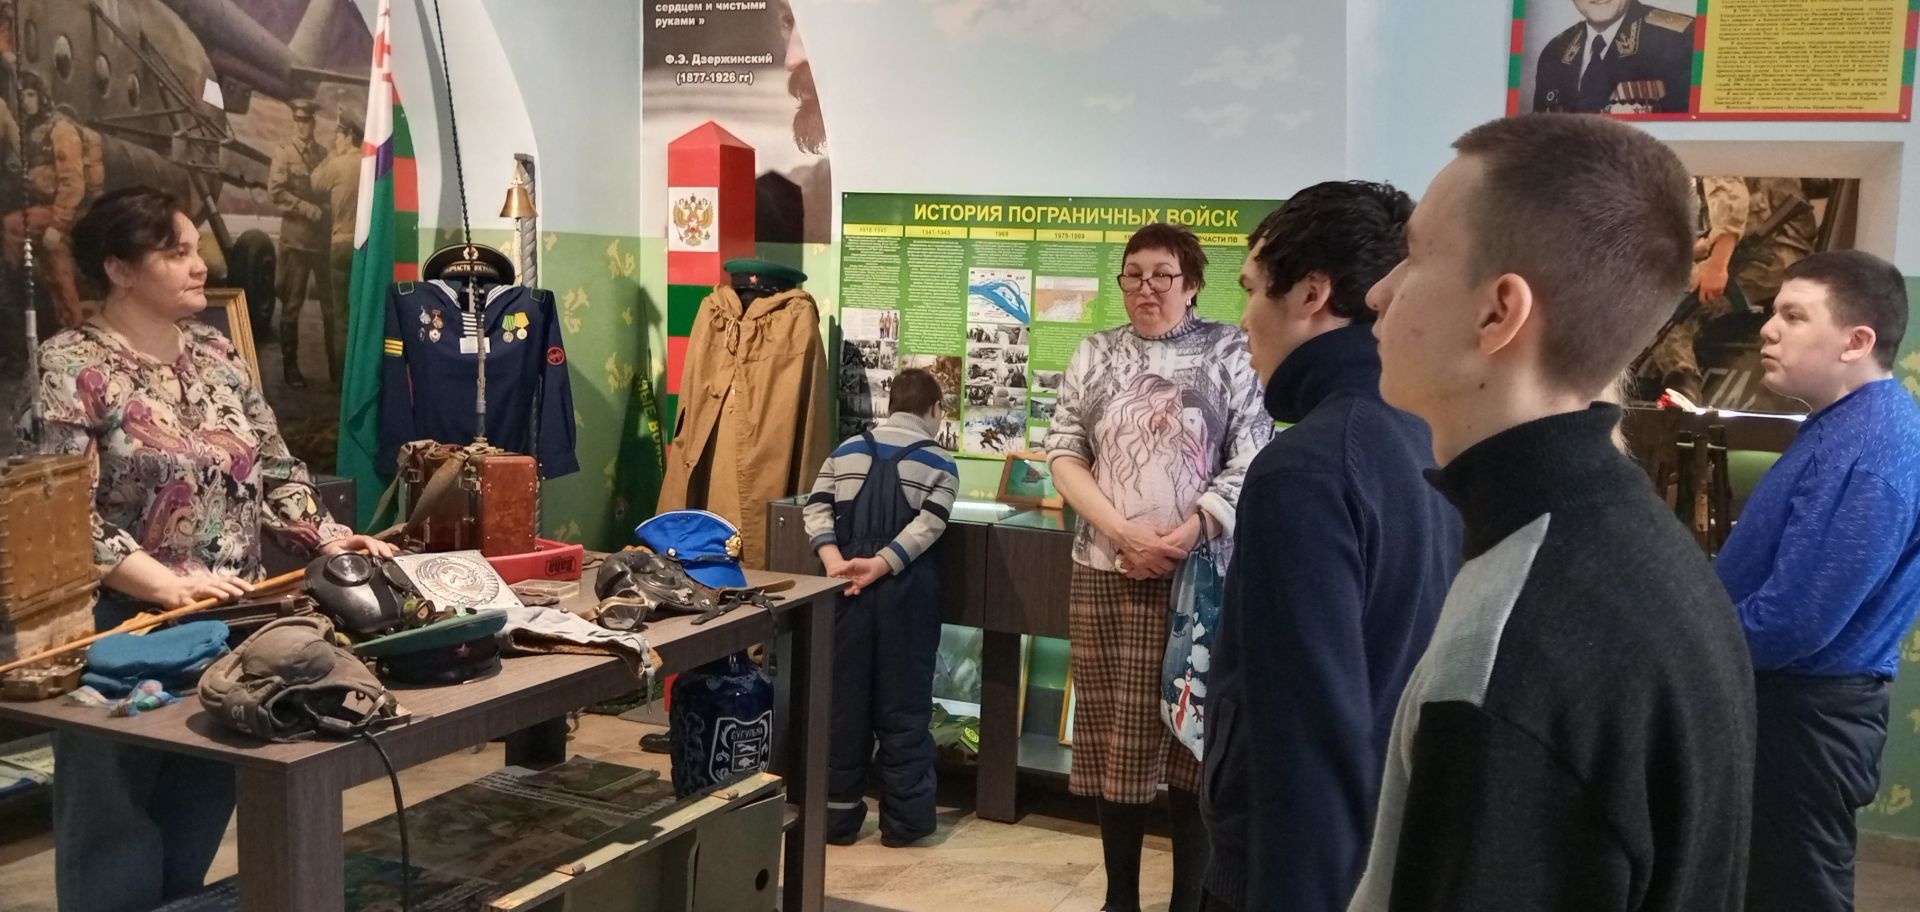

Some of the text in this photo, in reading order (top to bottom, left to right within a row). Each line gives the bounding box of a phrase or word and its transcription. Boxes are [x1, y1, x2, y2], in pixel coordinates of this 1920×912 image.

[655, 1, 766, 13] сердцем и чистыми
[655, 17, 696, 28] руками
[665, 53, 773, 66] Ф.Э. Дзержинский
[676, 72, 754, 85] (1877-1926 гг)
[914, 204, 1239, 228] ИСТОРИЯ ПОГРАНИЧНЫХ ВОЙСК
